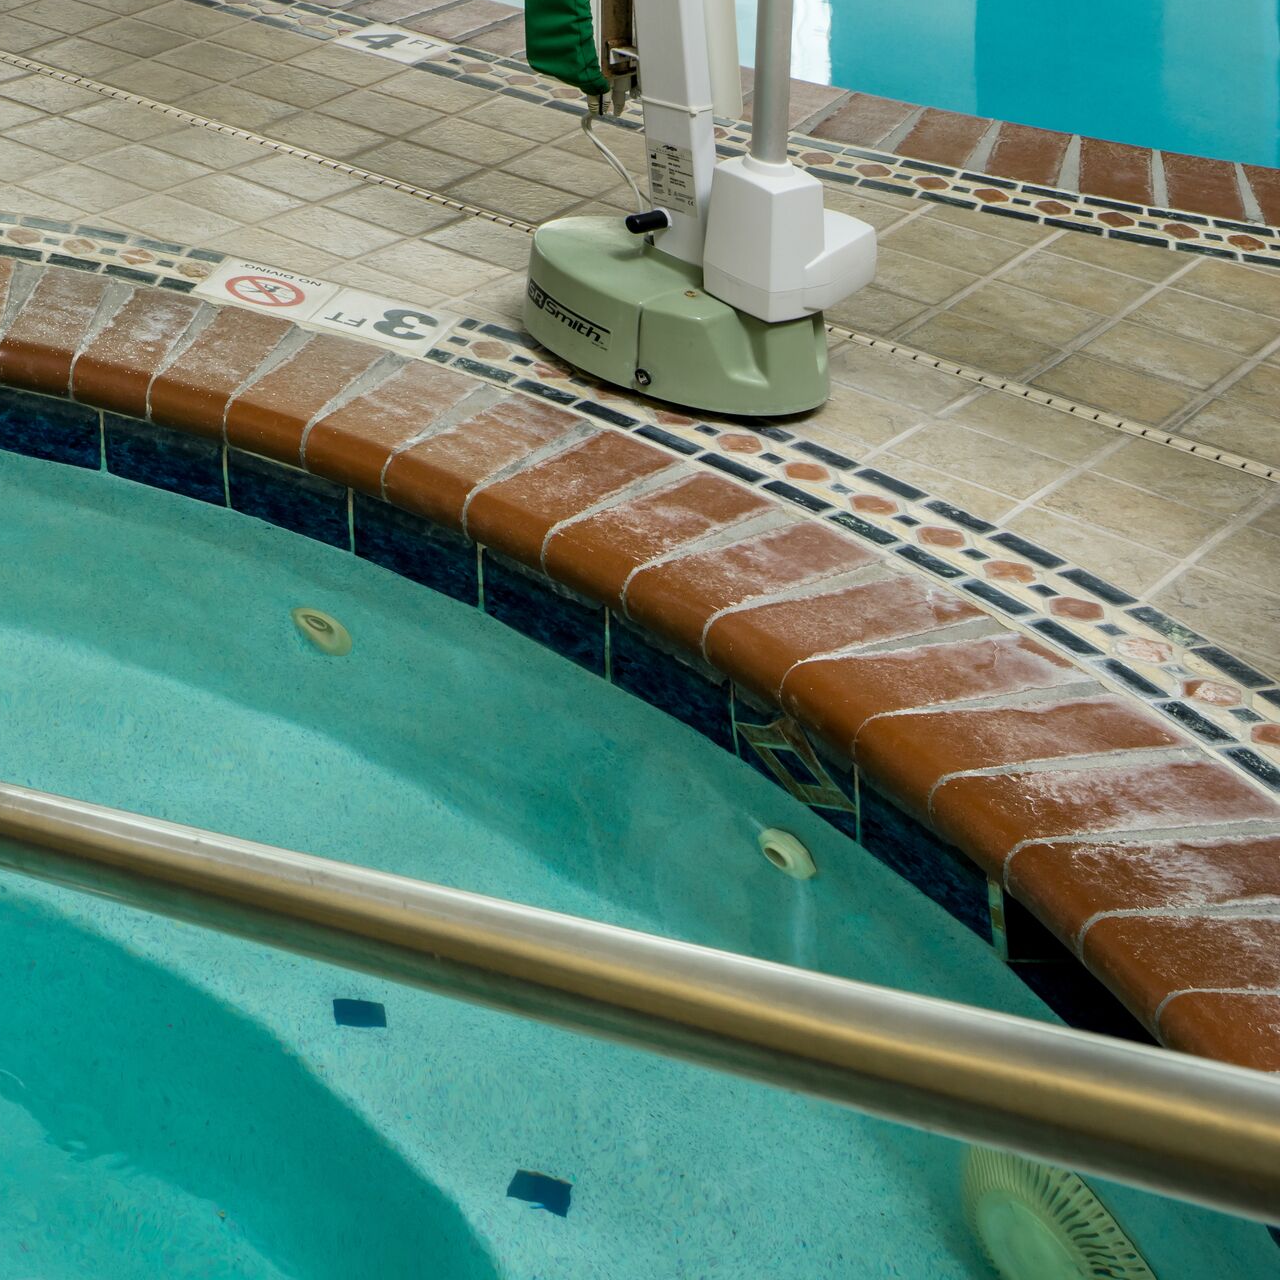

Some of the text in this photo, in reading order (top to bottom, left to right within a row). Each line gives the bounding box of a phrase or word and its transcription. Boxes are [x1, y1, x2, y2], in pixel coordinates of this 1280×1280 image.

[352, 33, 442, 51] 4 FT
[298, 278, 322, 287] NO
[324, 309, 439, 340] 3 FT
[545, 299, 601, 342] Smith
